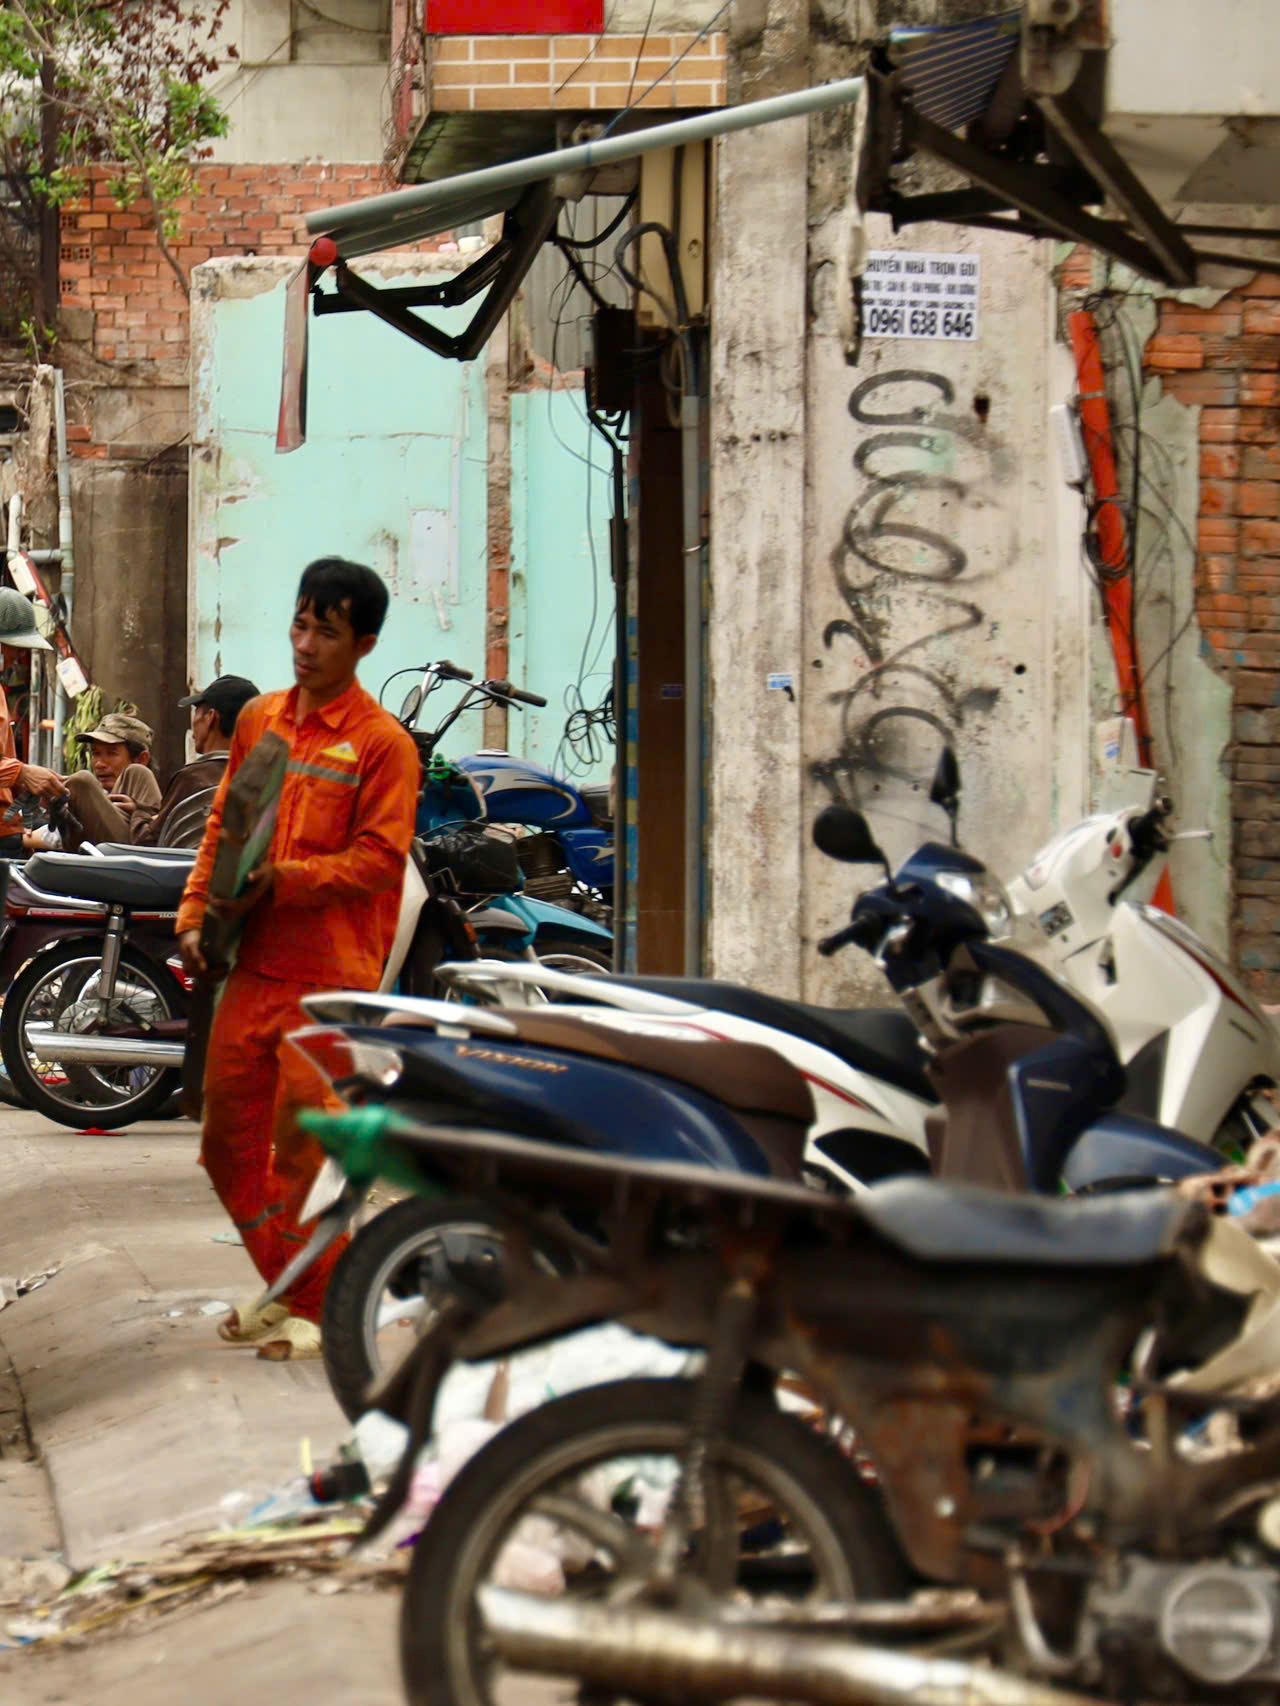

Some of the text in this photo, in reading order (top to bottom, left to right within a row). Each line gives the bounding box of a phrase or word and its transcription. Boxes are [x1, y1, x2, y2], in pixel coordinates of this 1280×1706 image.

[870, 308, 973, 338] 0961 638 646
[456, 1044, 568, 1075] VISION
